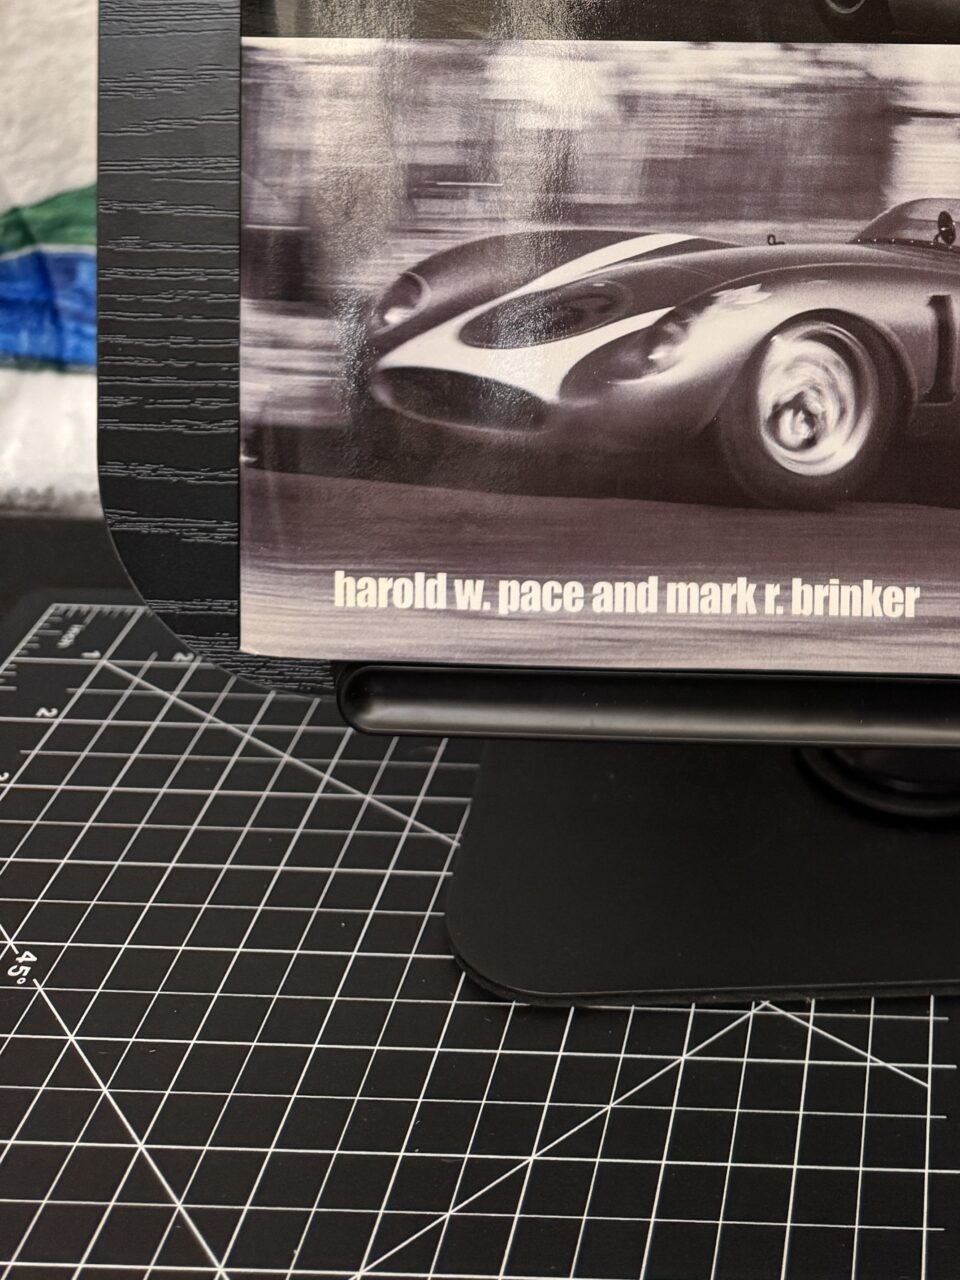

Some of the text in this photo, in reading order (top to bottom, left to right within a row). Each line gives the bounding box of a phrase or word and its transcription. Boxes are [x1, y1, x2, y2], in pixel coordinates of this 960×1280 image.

[333, 570, 921, 618] harold w. pace and mark r. brinker
[7, 950, 38, 985] 45°
